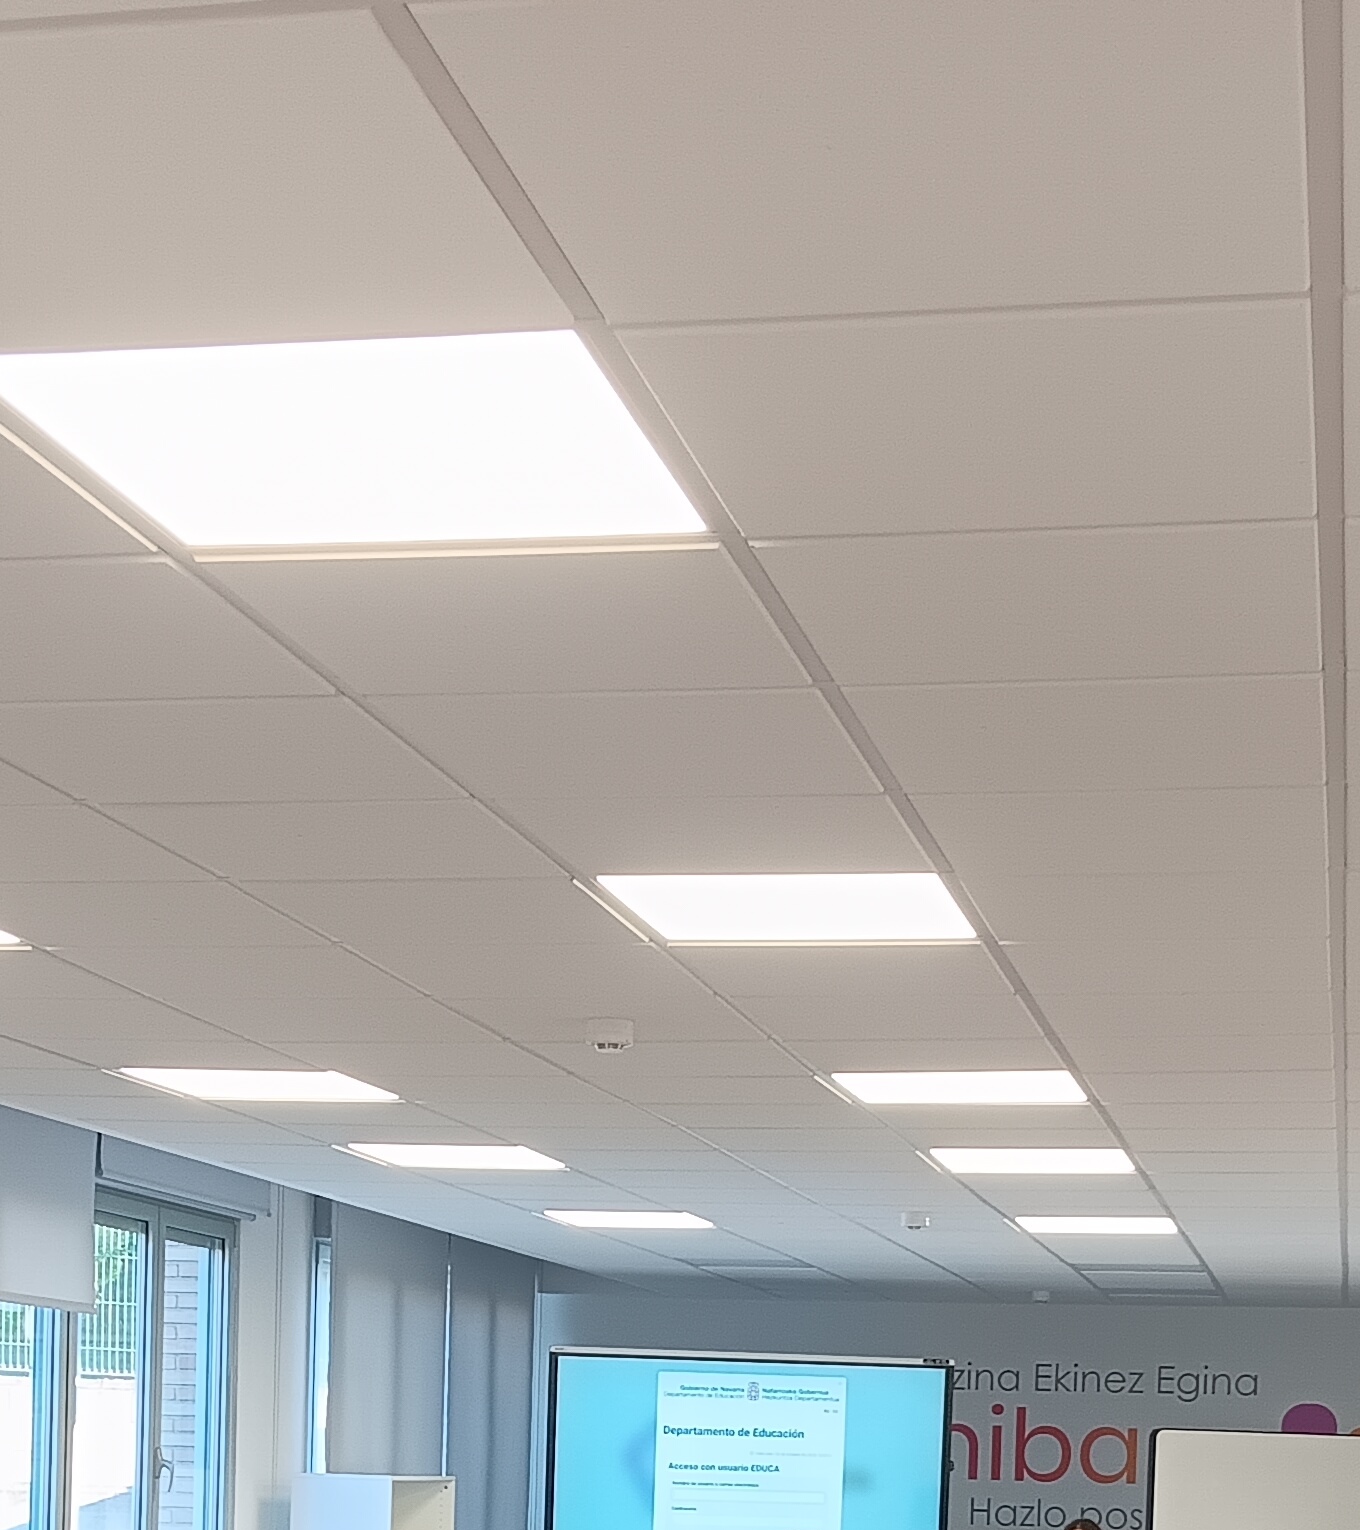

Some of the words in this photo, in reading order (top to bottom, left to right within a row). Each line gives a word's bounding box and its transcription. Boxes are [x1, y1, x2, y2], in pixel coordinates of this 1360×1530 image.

[1034, 1363, 1144, 1393] Ekinez
[1157, 1365, 1258, 1402] Egina
[663, 1425, 735, 1437] Departamento
[737, 1427, 750, 1437] de
[752, 1427, 805, 1439] Educación
[668, 1462, 699, 1470] Acceso
[700, 1463, 716, 1471] con
[717, 1463, 749, 1472] usuario
[750, 1464, 780, 1473] EDUCA
[970, 1497, 1066, 1528] Hazlo
